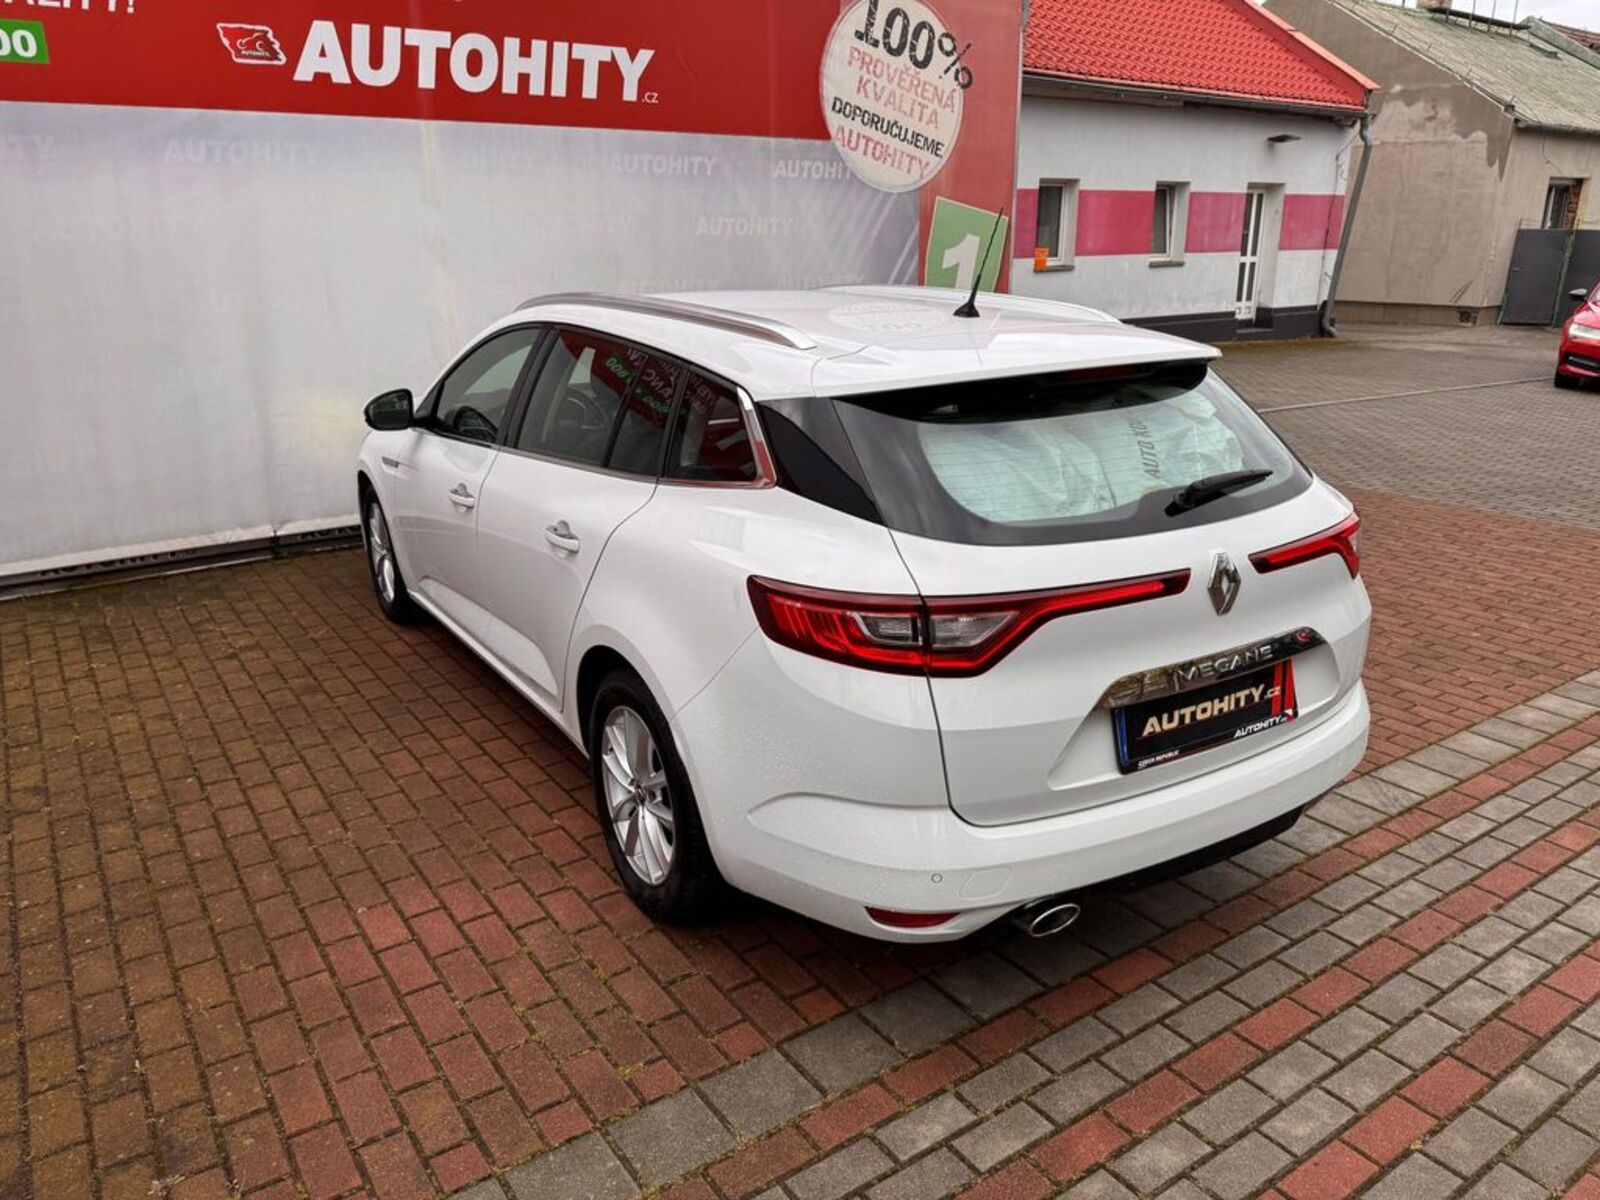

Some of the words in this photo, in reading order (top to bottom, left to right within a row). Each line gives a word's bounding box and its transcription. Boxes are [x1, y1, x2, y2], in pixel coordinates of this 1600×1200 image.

[854, 0, 973, 89] 100%
[832, 96, 945, 159] DOPORUČUJEME
[856, 76, 939, 129] KVALITA
[609, 153, 717, 176] AUTOHITY
[836, 124, 931, 178] AUTOHITY
[696, 216, 794, 237] AUTOHITY
[942, 233, 980, 289] 1
[1137, 440, 1161, 480] AUTO
